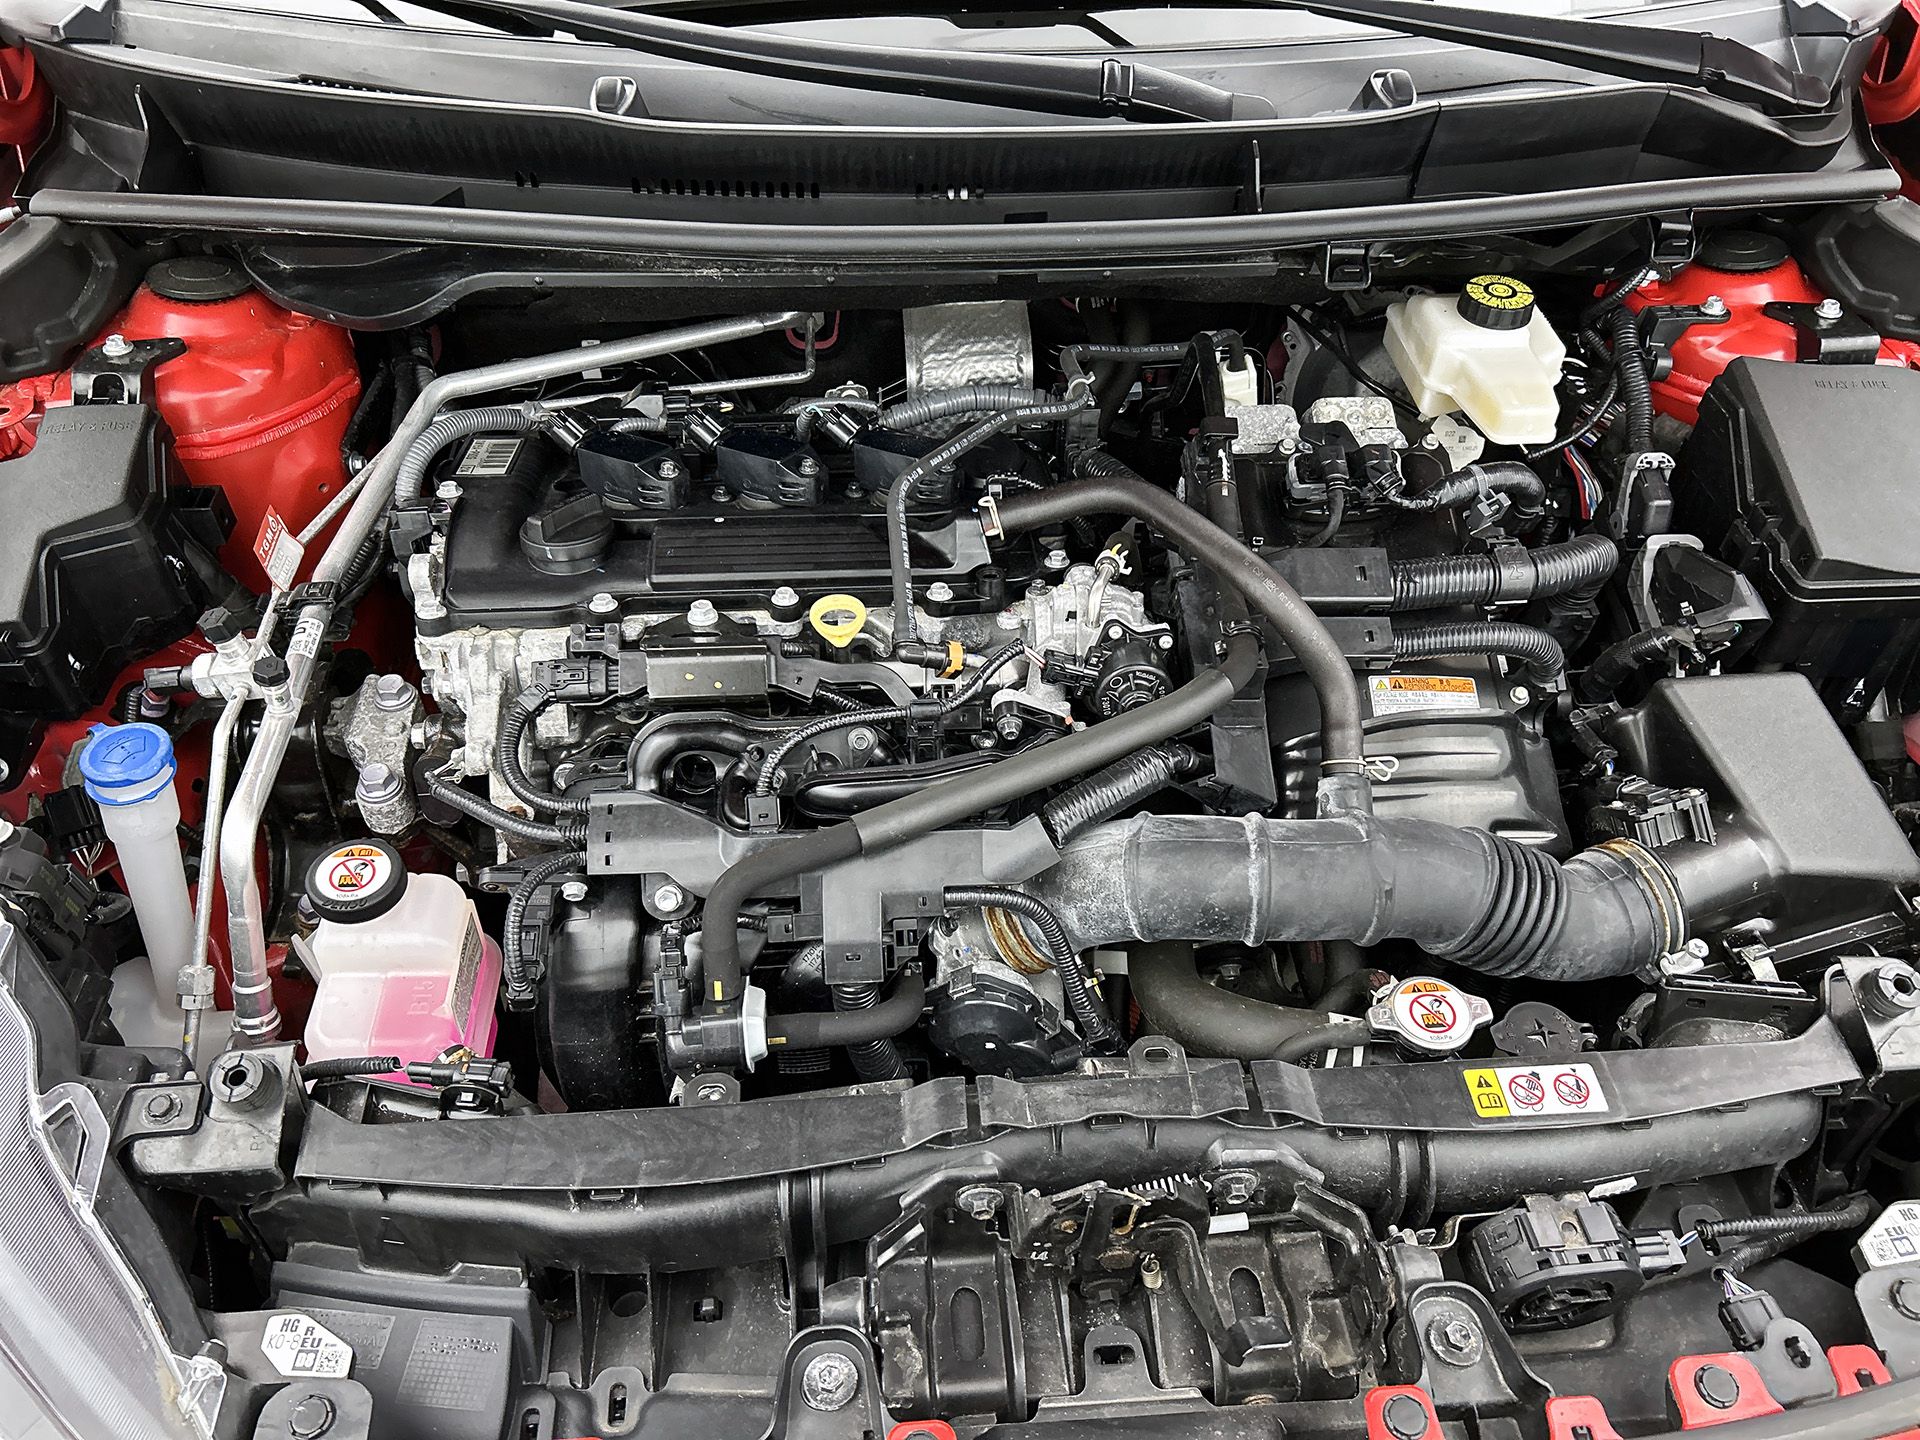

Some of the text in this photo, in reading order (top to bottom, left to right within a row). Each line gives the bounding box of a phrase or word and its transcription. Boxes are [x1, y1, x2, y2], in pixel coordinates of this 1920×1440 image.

[45, 421, 86, 435] RELAY
[1403, 677, 1430, 685] WARNING
[1898, 1207, 1919, 1221] HG
[1884, 1225, 1904, 1237] EU
[280, 1318, 300, 1332] HG
[304, 1326, 316, 1336] R
[300, 1337, 323, 1348] EU
